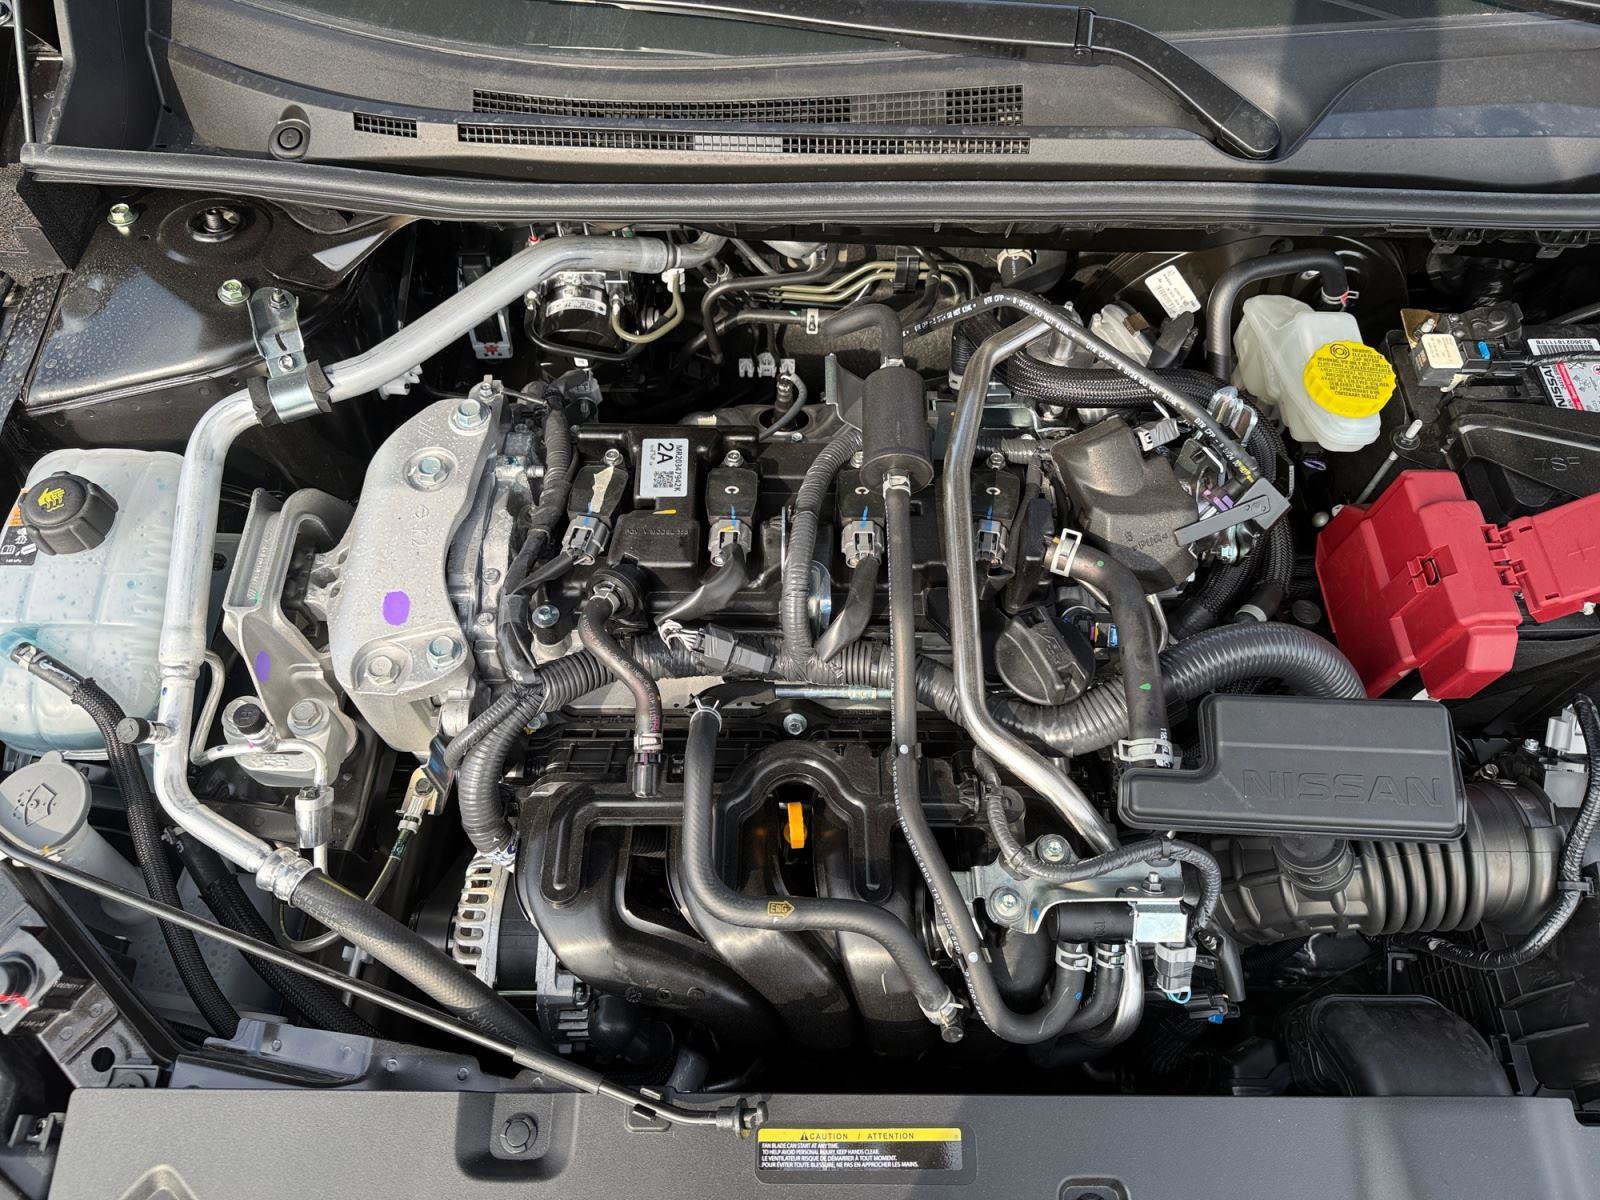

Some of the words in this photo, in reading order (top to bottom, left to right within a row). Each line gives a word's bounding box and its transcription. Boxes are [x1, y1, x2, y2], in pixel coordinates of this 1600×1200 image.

[1543, 365, 1568, 408] NISSA
[656, 442, 675, 466] 2A
[1242, 769, 1443, 808] NISSAN
[770, 903, 788, 913] ENG
[809, 1132, 848, 1140] CAUTION
[867, 1132, 914, 1140] ATTENTION
